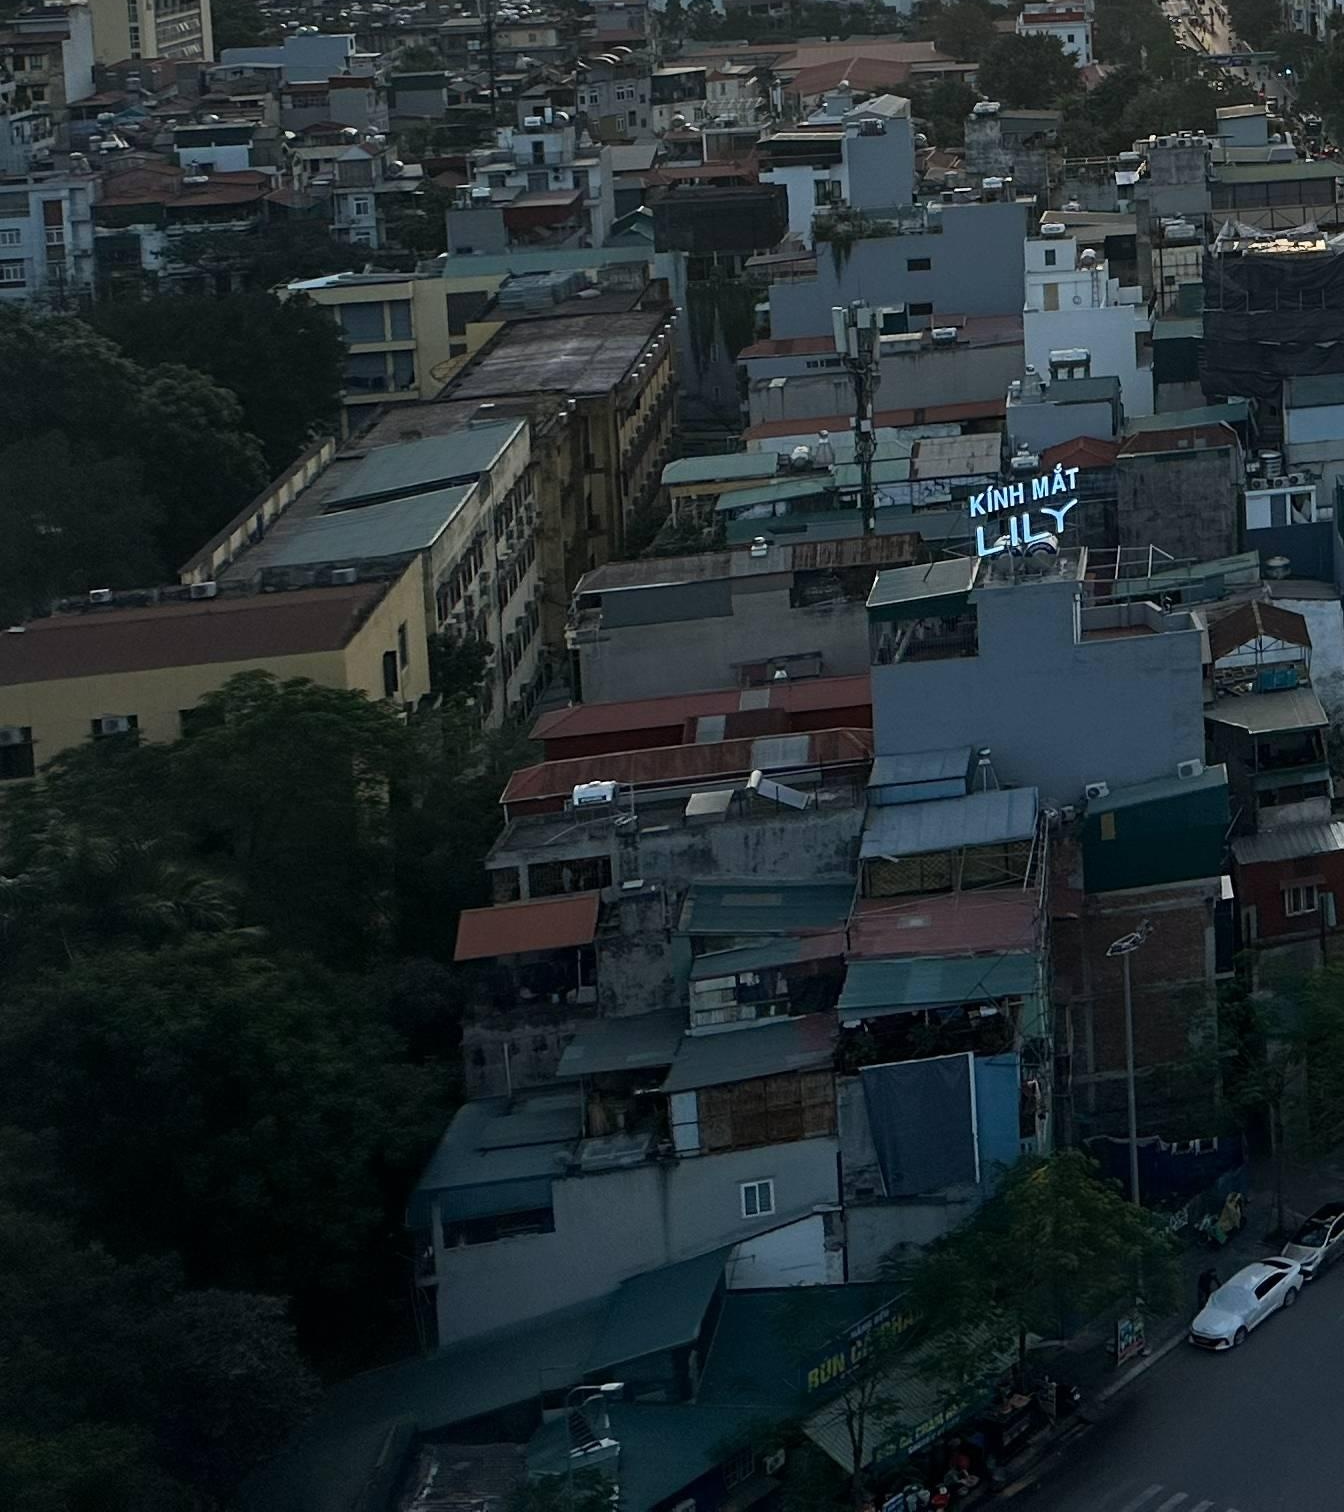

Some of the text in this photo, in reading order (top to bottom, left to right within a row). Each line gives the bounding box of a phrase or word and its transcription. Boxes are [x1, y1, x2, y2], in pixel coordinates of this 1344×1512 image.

[969, 462, 1080, 517] KÍNH MẮT
[976, 498, 1078, 557] LILY
